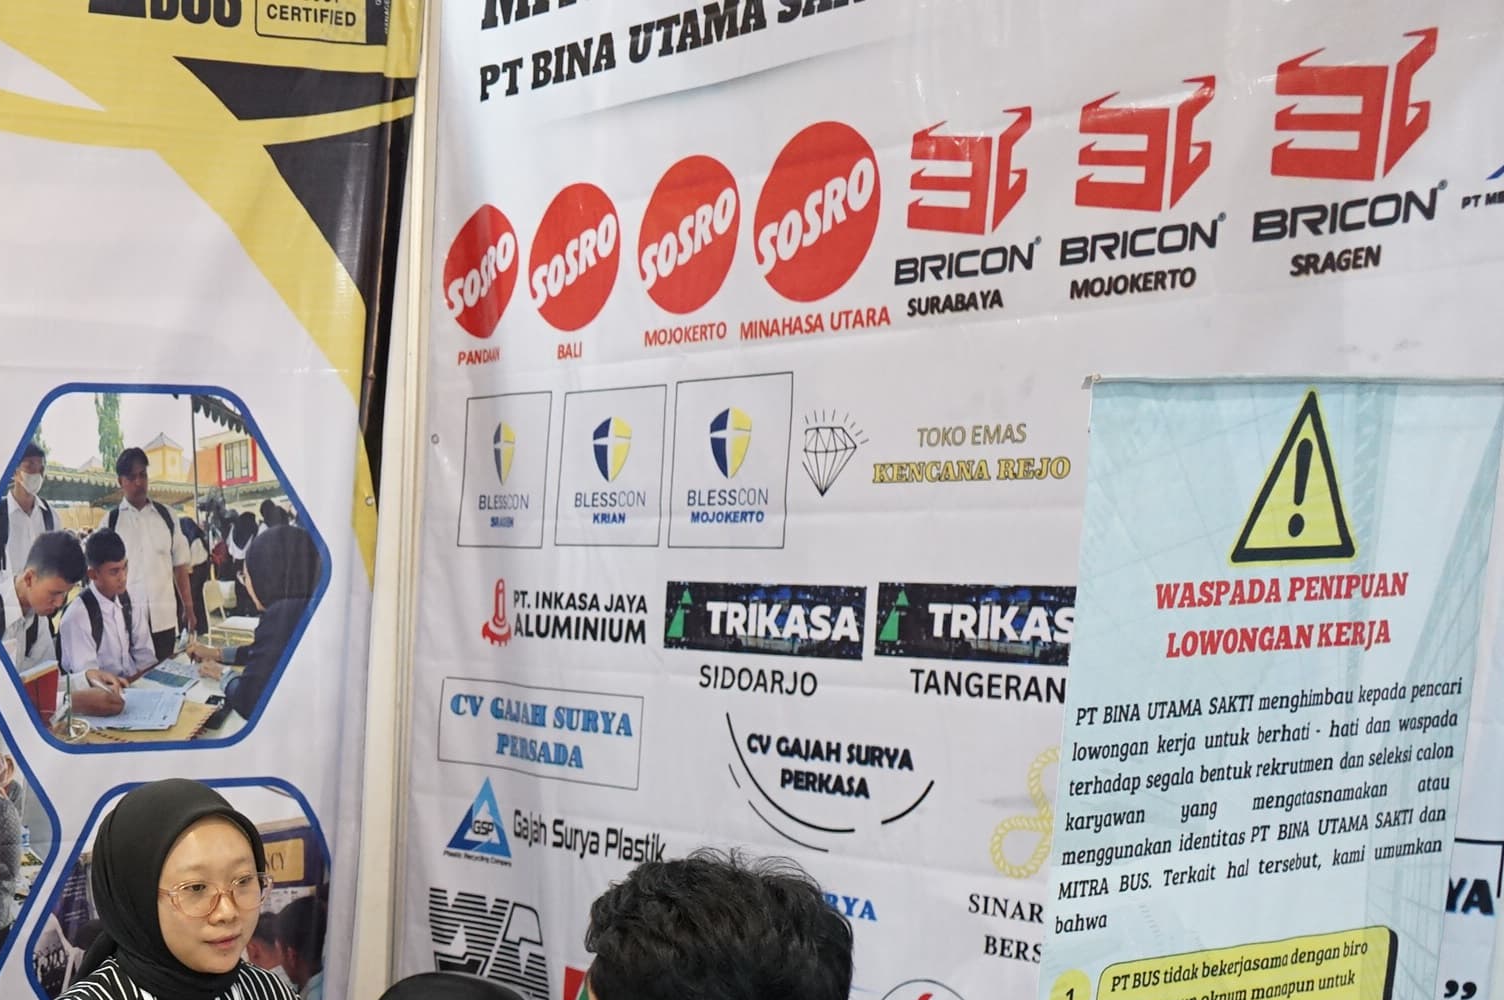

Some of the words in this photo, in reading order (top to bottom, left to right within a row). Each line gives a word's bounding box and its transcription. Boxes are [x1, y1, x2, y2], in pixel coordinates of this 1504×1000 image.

[266, 4, 356, 27] CERTIFIED
[479, 58, 523, 103] PT
[531, 32, 616, 90] BINA
[629, 0, 767, 64] UTAMA
[756, 158, 875, 274] SOSRO
[1461, 194, 1482, 209] PT
[641, 188, 736, 290] SOSRO
[445, 233, 515, 319] SOSRO
[531, 213, 617, 309] SOSRO
[1290, 245, 1381, 276] SRAGEN
[1070, 267, 1197, 299] MOJOKERTO
[907, 288, 1003, 317] SURABAYA
[644, 322, 727, 347] MOJOKERTO
[740, 314, 824, 341] MINAHASA
[830, 306, 891, 331] UTARA
[557, 342, 583, 359] BALI
[917, 427, 966, 447] TOKO
[971, 424, 1027, 446] EMAS
[873, 460, 991, 482] KENCANA
[997, 457, 1070, 480] REJO
[574, 492, 646, 507] BLESSCON
[687, 489, 768, 506] BLESSCON
[593, 512, 625, 524] KRIAN
[691, 511, 764, 523] MOJOKERTO
[514, 590, 530, 608] PT.
[535, 591, 600, 611] INKASA
[604, 594, 647, 613] JAYA
[1155, 579, 1281, 609] WASPADA
[1288, 573, 1409, 602] PENIPUAN
[514, 614, 646, 644] ALUMINIUM
[706, 601, 859, 642] TRIKASA
[1166, 624, 1314, 658] LOWONGAN
[1317, 620, 1391, 651] KERJA
[699, 665, 817, 696] SIDOARJO
[451, 694, 485, 716] CV
[490, 698, 547, 727] GAJAH
[553, 707, 632, 736] SURYA
[1103, 703, 1141, 725] BINA
[1147, 699, 1202, 721] UTAMA
[1209, 694, 1255, 716] SAKTI
[1258, 686, 1354, 713] menghimbau
[1358, 682, 1408, 708] kepada
[1411, 678, 1462, 704] pencari
[496, 733, 583, 769] PERSADA
[747, 733, 771, 754] CV
[776, 736, 841, 762] GAJAH
[847, 744, 914, 771] SURYA
[1072, 742, 1148, 763] lowongan
[1257, 723, 1311, 745] berhati
[1399, 713, 1458, 735] waspada
[781, 768, 869, 799] PERKASA
[1069, 774, 1141, 796] terhadap
[1200, 762, 1252, 784] bentuk
[1256, 756, 1333, 778] rekrutmen
[1368, 747, 1411, 767] seleksi
[1065, 808, 1146, 832] karyawan
[1253, 782, 1388, 813] mengatasnamakan
[473, 820, 494, 835] GSP
[514, 809, 547, 848] Gajah
[552, 819, 599, 859] Surya
[605, 828, 666, 863] Plastik
[1062, 836, 1172, 867] menggunakan
[1179, 826, 1246, 851] identitas
[1058, 878, 1109, 900] MITRA
[1163, 866, 1217, 887] Terkait
[1258, 853, 1322, 875] tersebut,
[1374, 838, 1442, 861] umumkan
[968, 894, 1044, 924] SINAR
[1054, 912, 1108, 934] bahwa
[1202, 953, 1288, 979] bekerjasama
[1291, 946, 1339, 969] dengan
